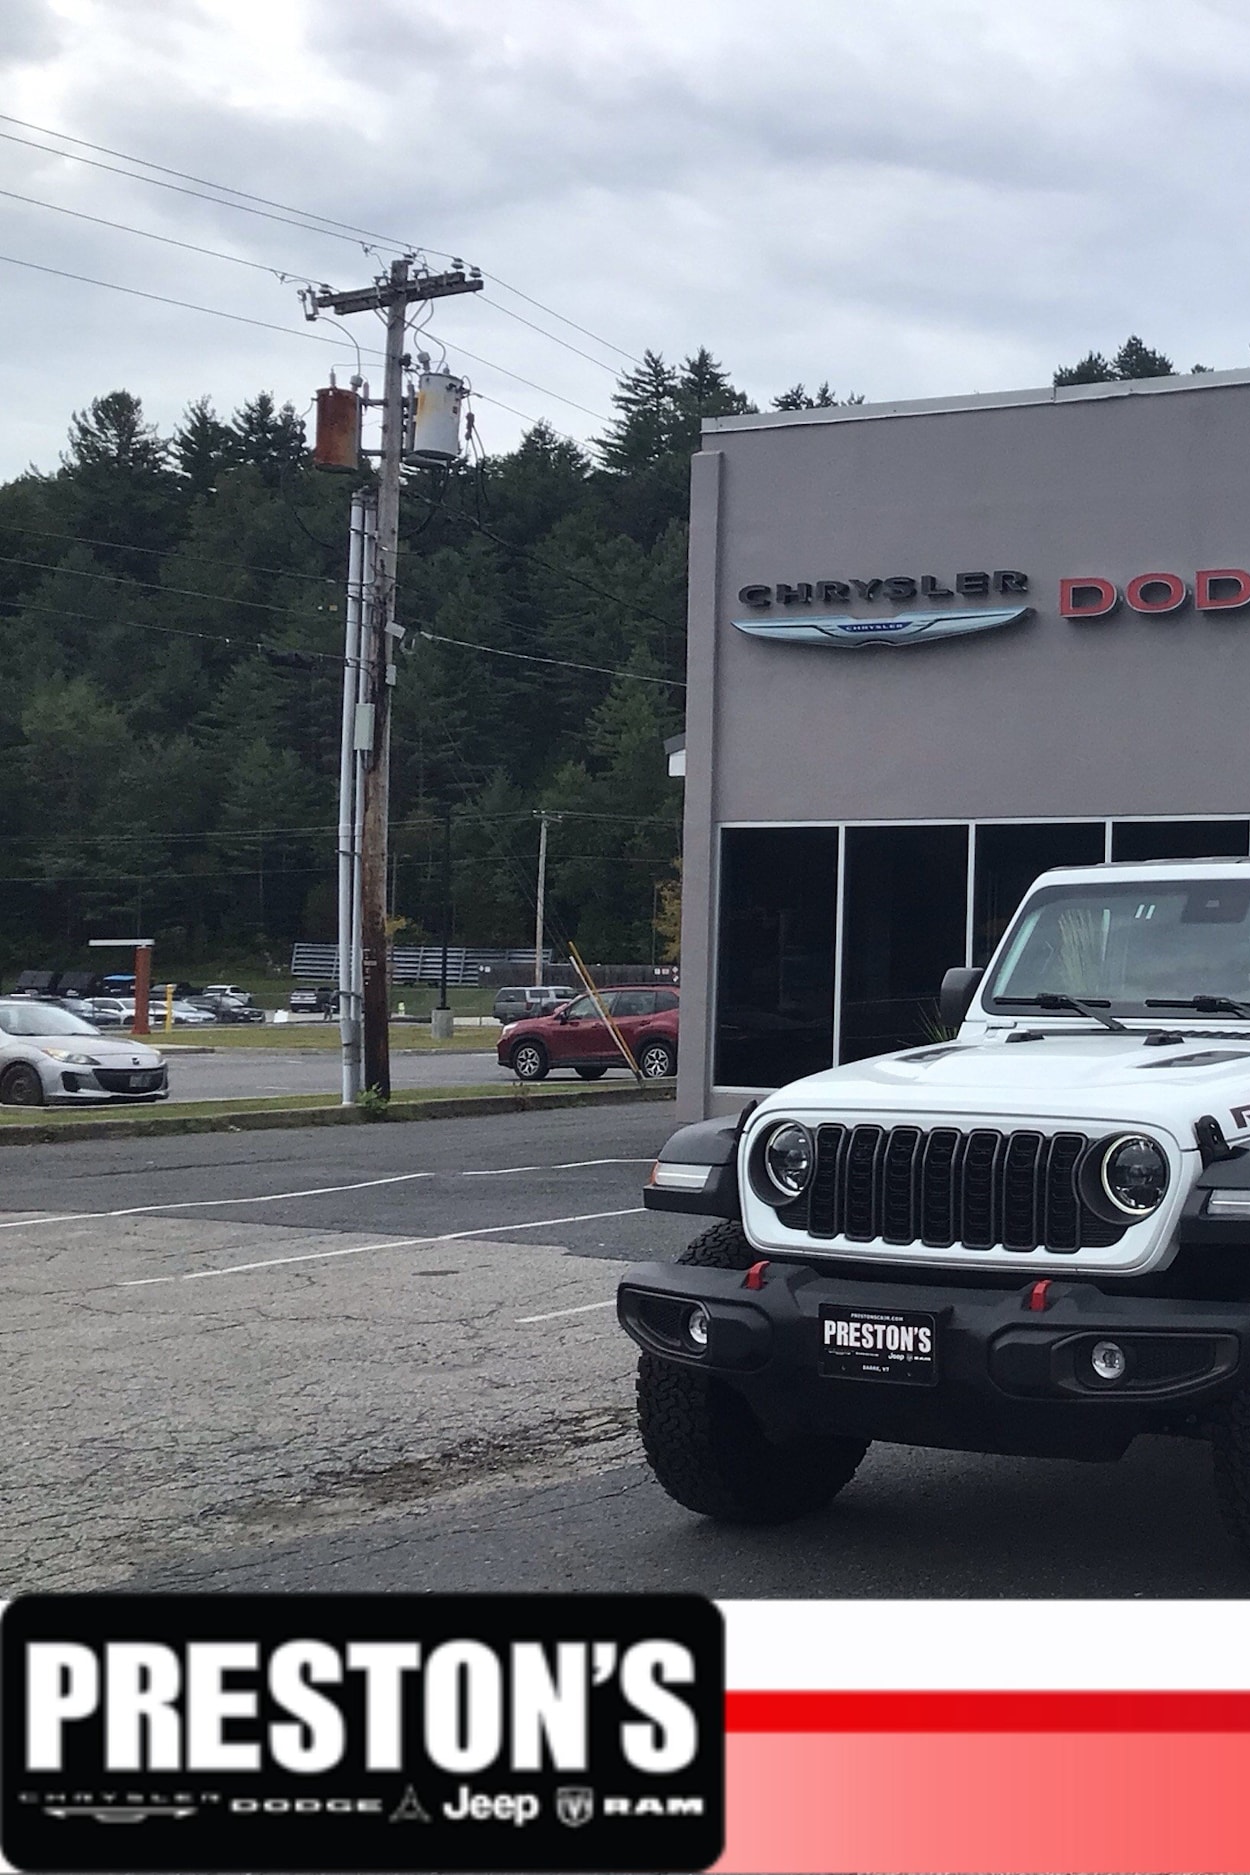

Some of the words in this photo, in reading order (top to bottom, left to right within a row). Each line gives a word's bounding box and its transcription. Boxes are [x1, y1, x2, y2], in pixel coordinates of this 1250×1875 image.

[738, 570, 1029, 608] CHRYSLER
[846, 623, 903, 631] CHRYSLER
[824, 1319, 932, 1354] PRESTON'S
[887, 1352, 905, 1361] Jeep
